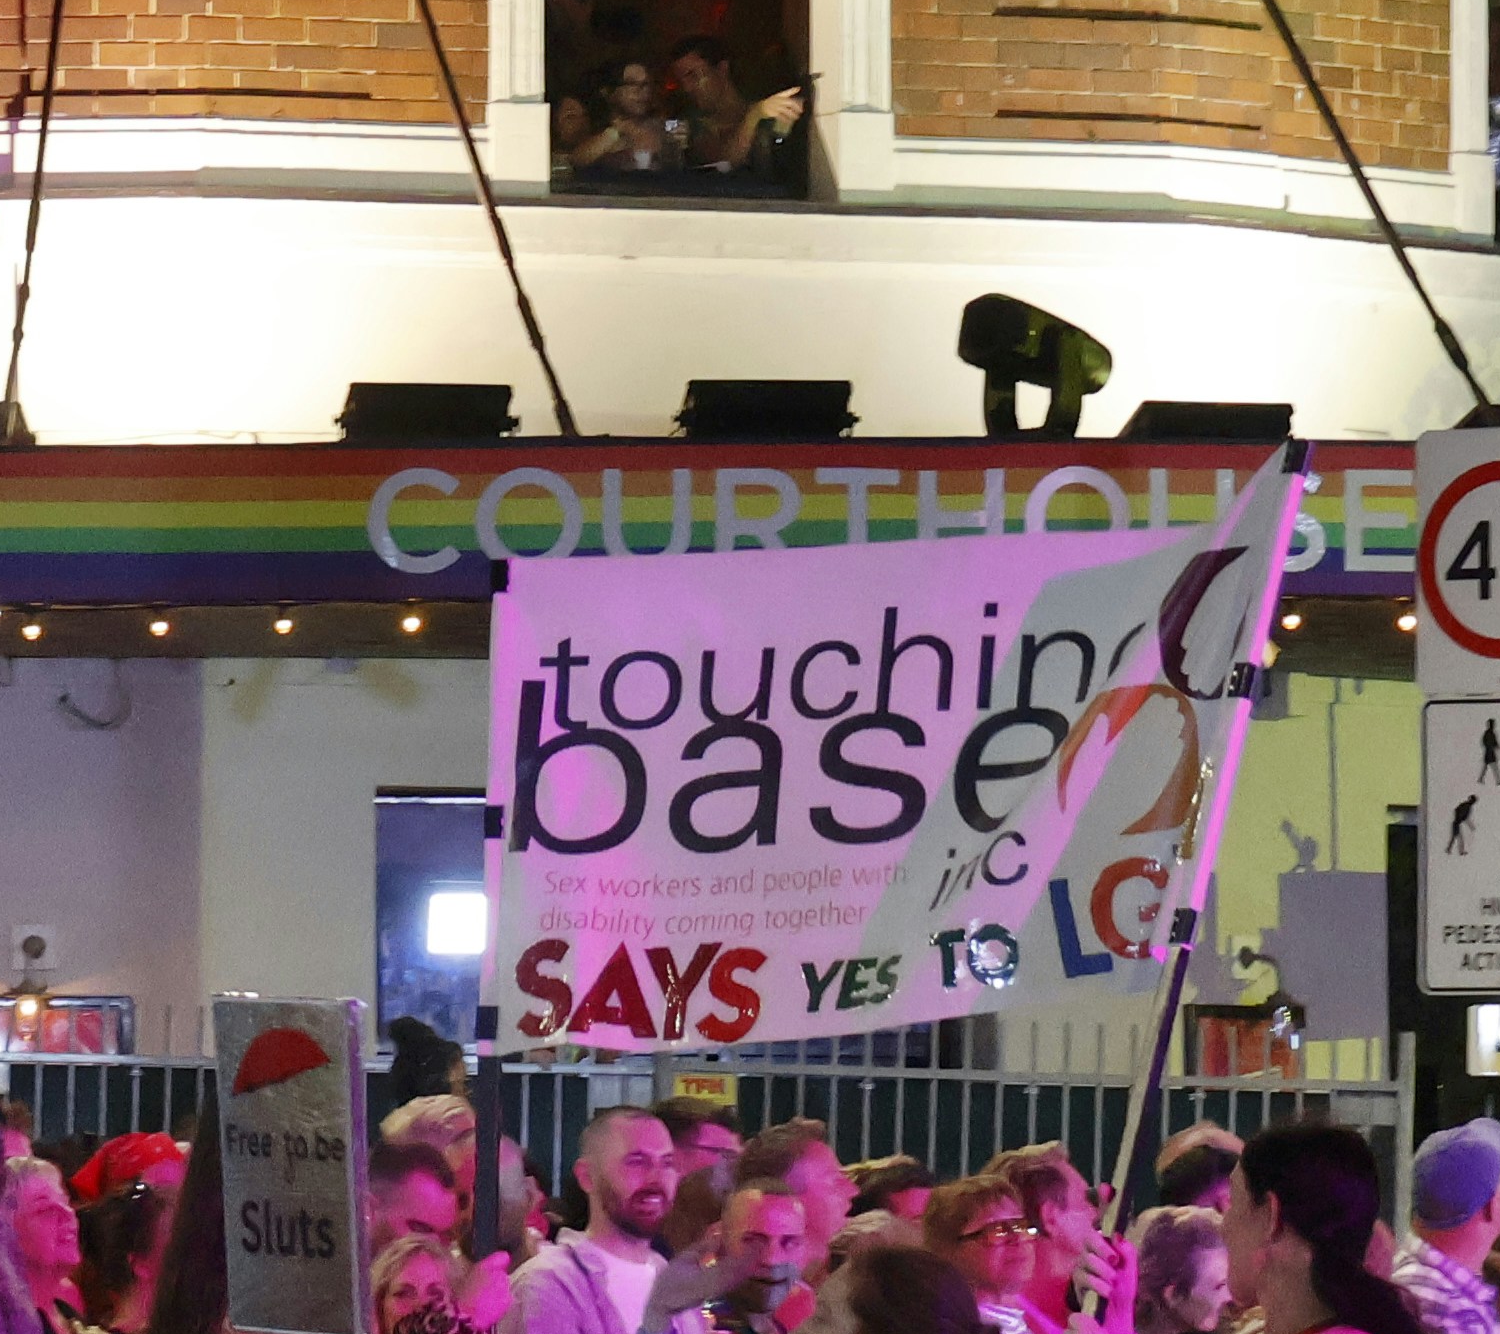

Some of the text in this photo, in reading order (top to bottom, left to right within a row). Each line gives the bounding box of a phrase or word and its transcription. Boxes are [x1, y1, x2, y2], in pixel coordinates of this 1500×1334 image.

[509, 679, 1070, 855] base
[543, 864, 907, 901] Sex workers and people with
[540, 901, 871, 940] disability coming together
[515, 939, 768, 1043] SAYS
[801, 953, 903, 1013] YES
[928, 921, 1020, 990] TO
[225, 1123, 346, 1162] Free to be
[240, 1199, 336, 1259] Sluts
